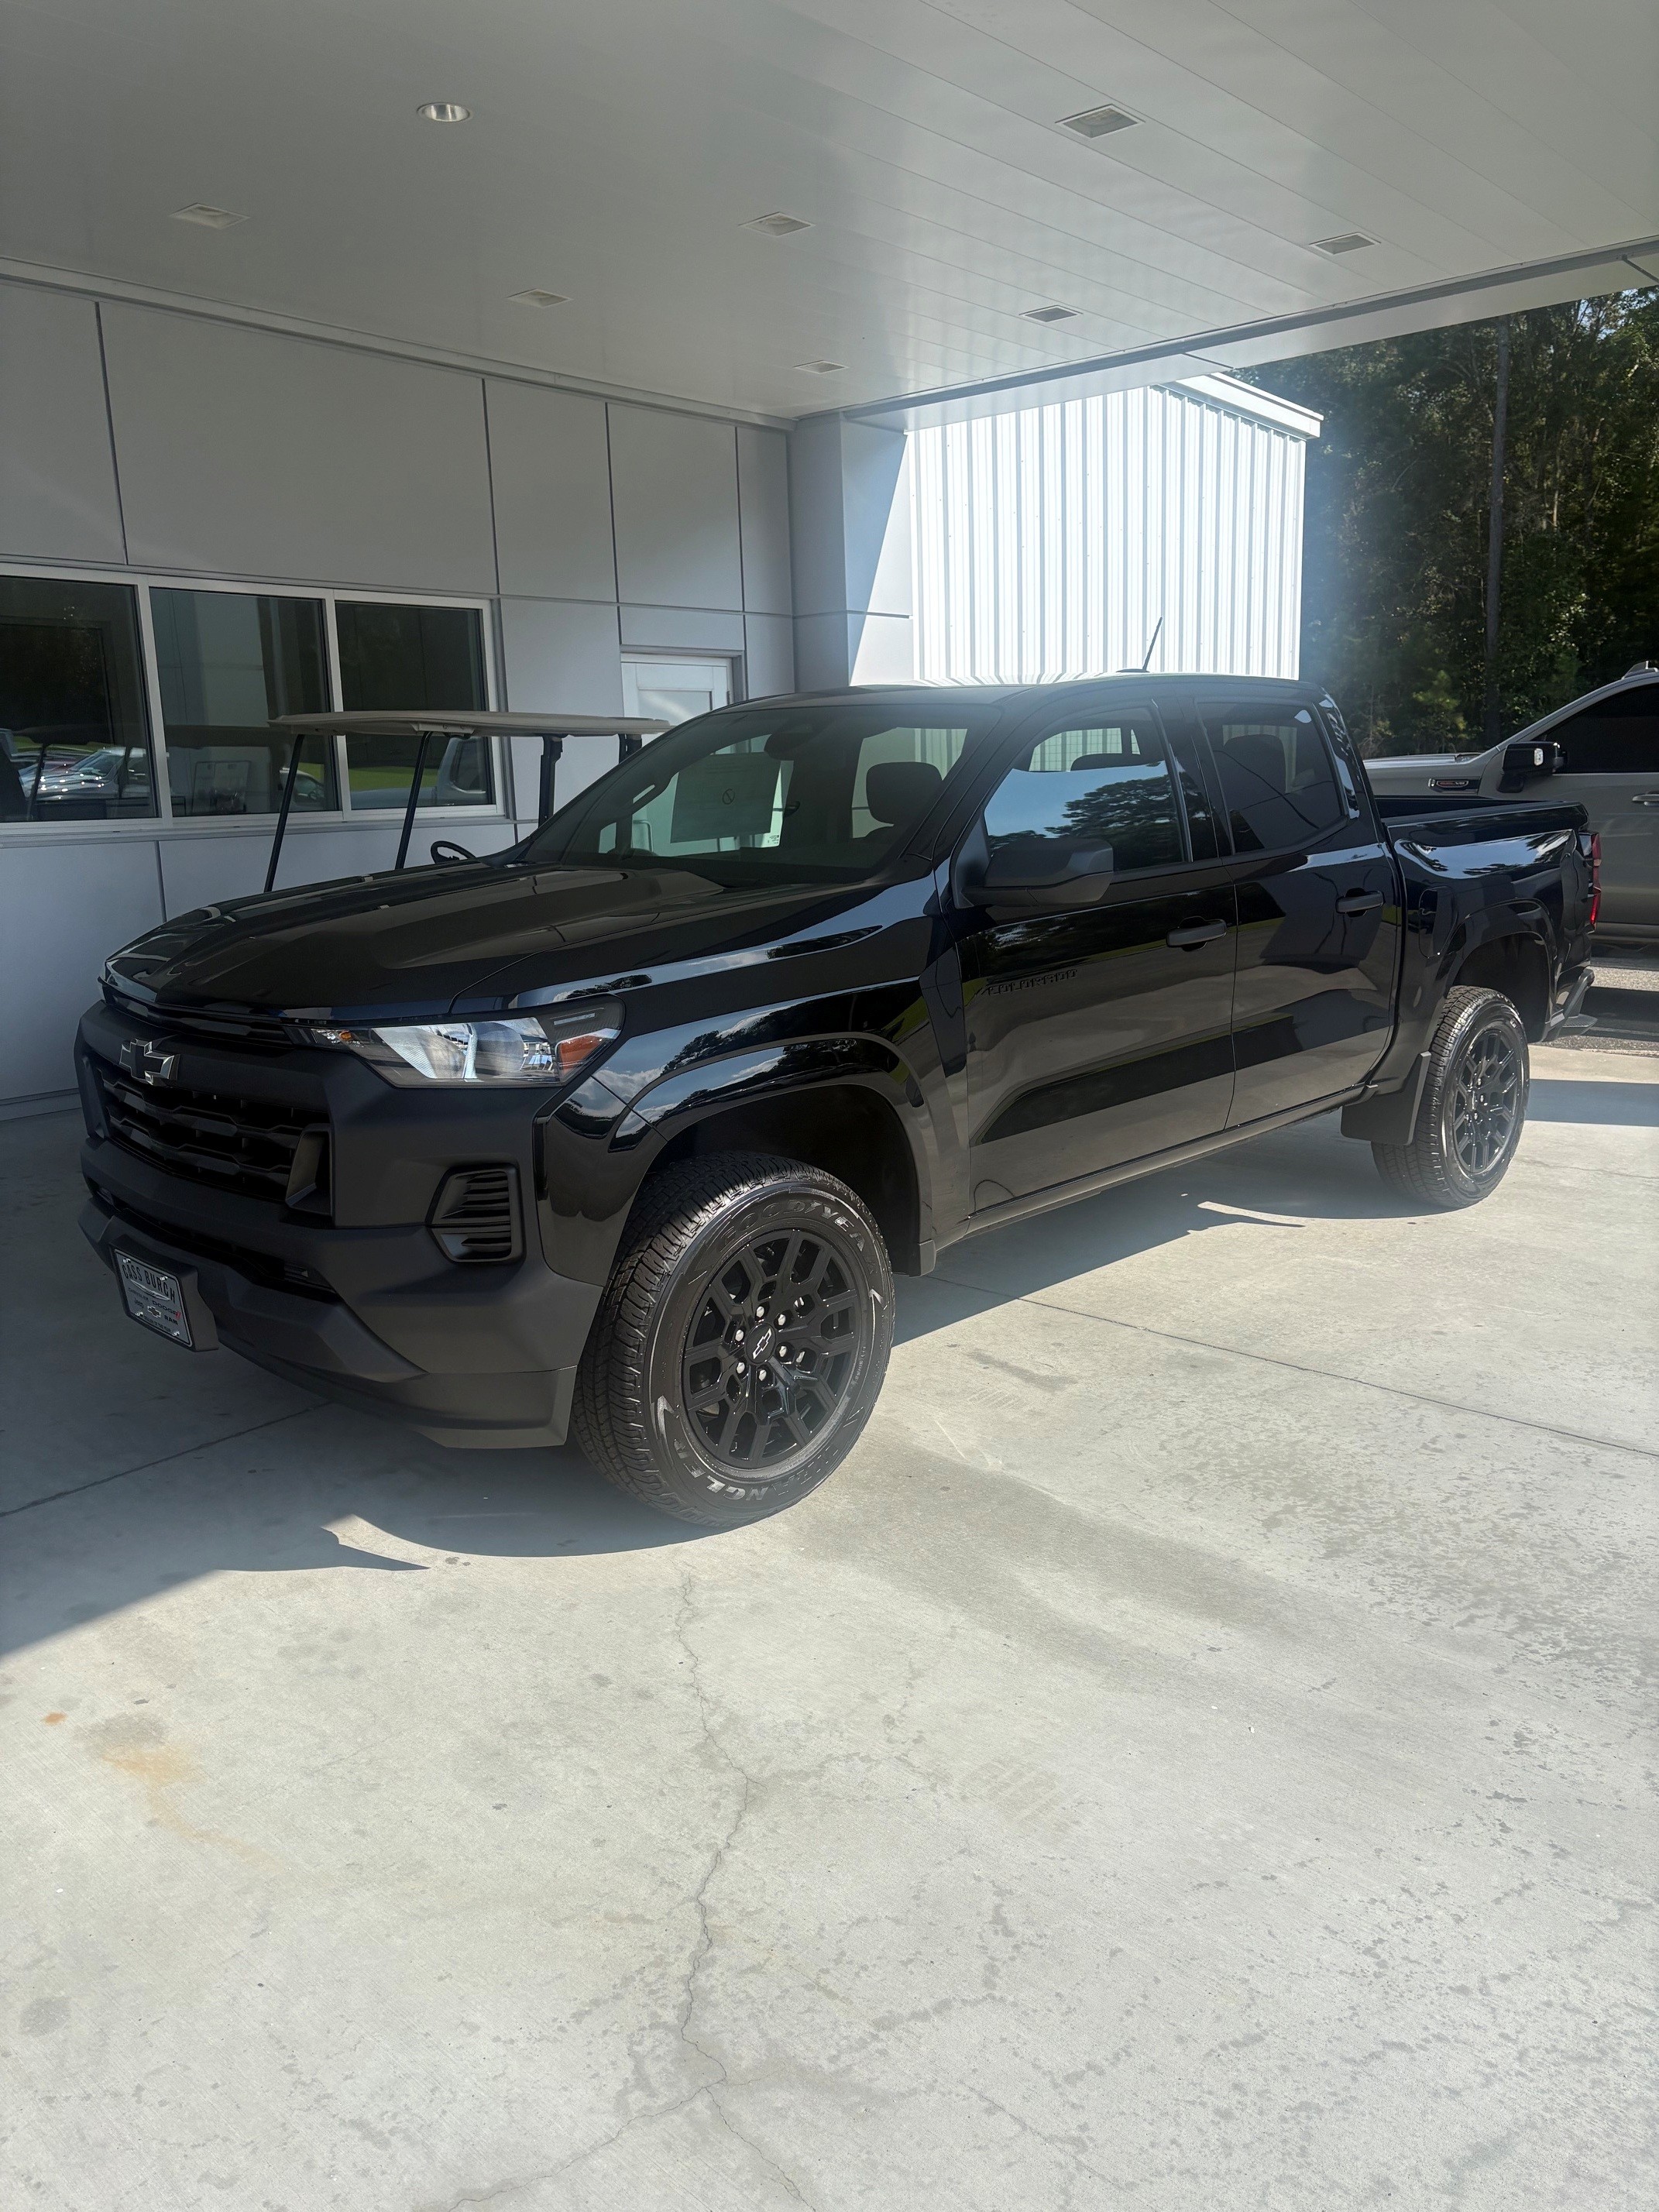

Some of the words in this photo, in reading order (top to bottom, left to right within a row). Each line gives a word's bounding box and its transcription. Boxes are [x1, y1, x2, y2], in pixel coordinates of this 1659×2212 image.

[984, 968, 1077, 995] COLORADO
[122, 1264, 143, 1282] CASS
[144, 1270, 176, 1304] BURCH
